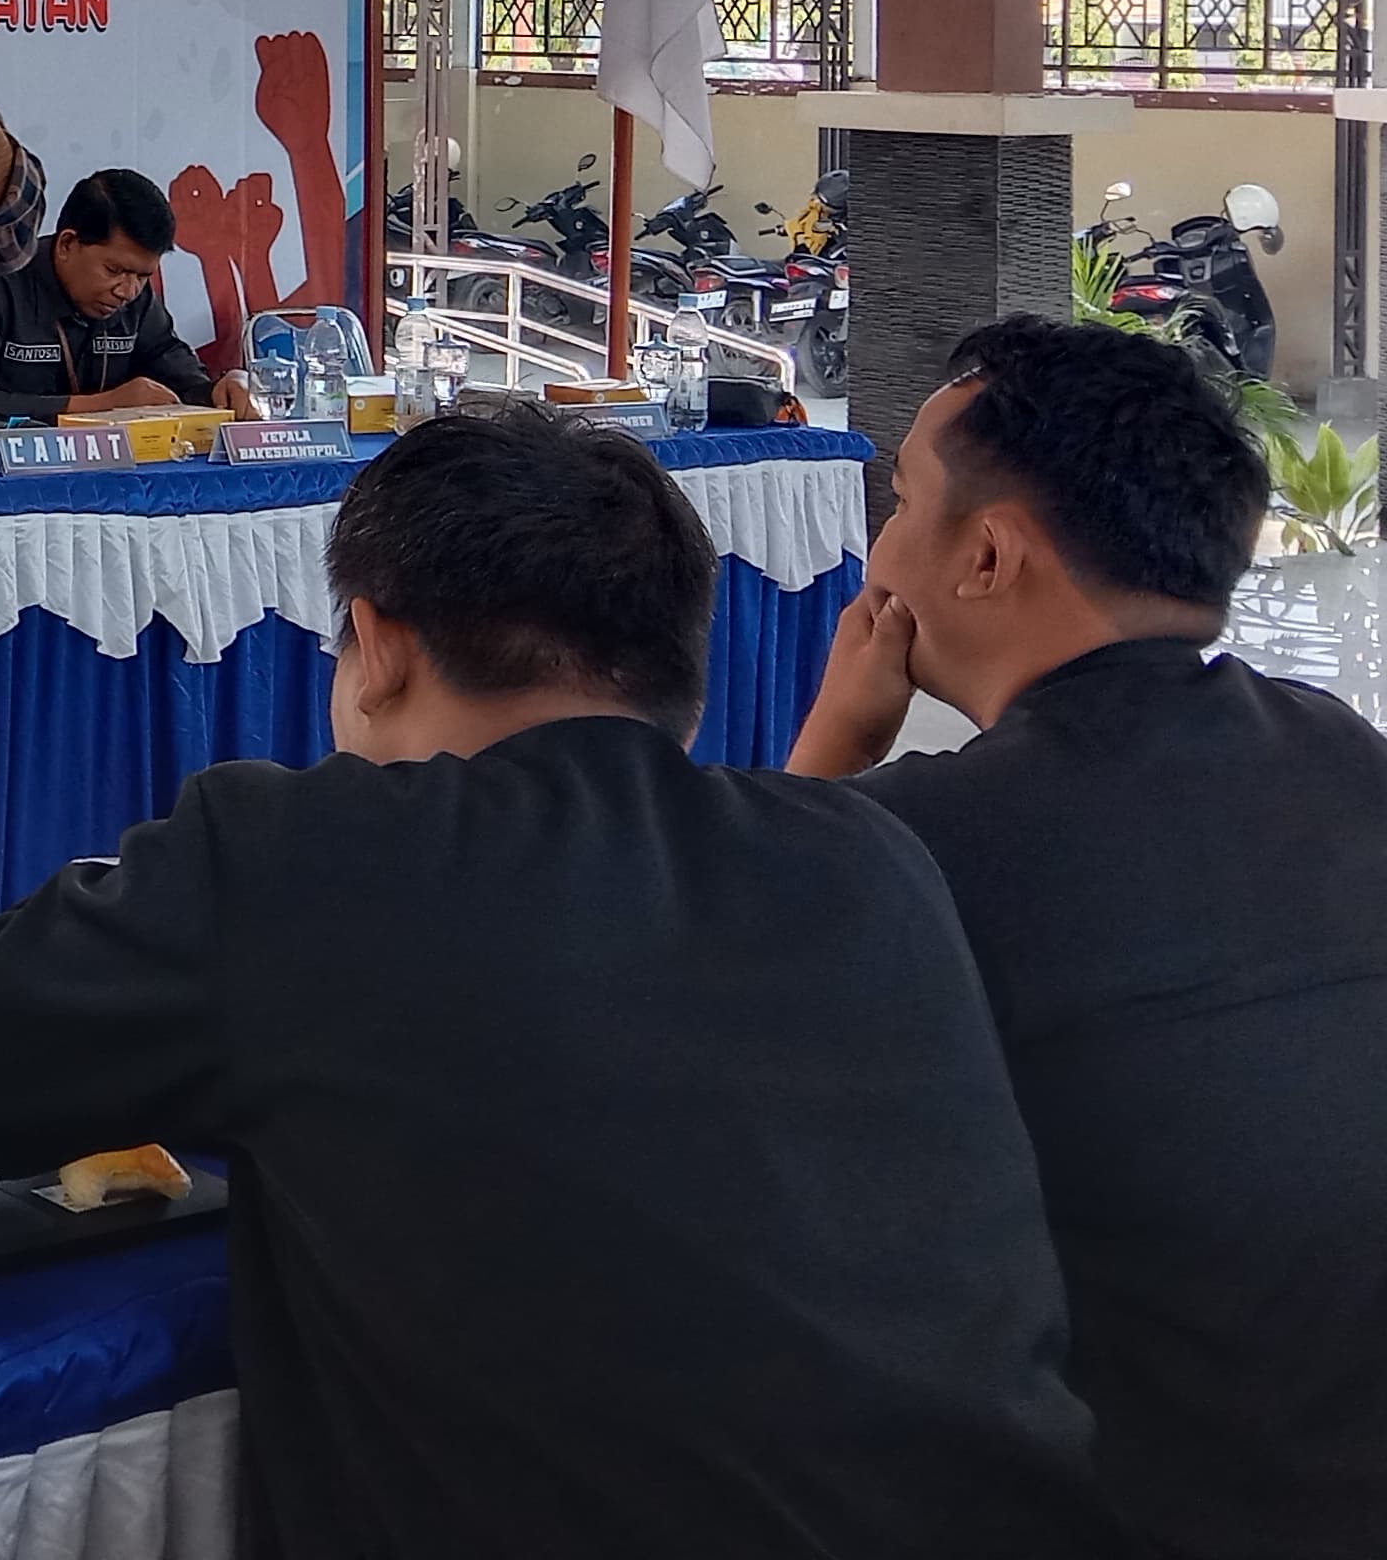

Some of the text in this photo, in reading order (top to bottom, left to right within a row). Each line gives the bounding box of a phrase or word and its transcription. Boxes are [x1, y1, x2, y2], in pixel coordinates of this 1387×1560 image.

[8, 345, 59, 360] SANTOSA
[260, 430, 312, 444] KEPALA
[6, 433, 122, 464] CAMAT
[238, 444, 341, 461] BAKESBANGPOL
